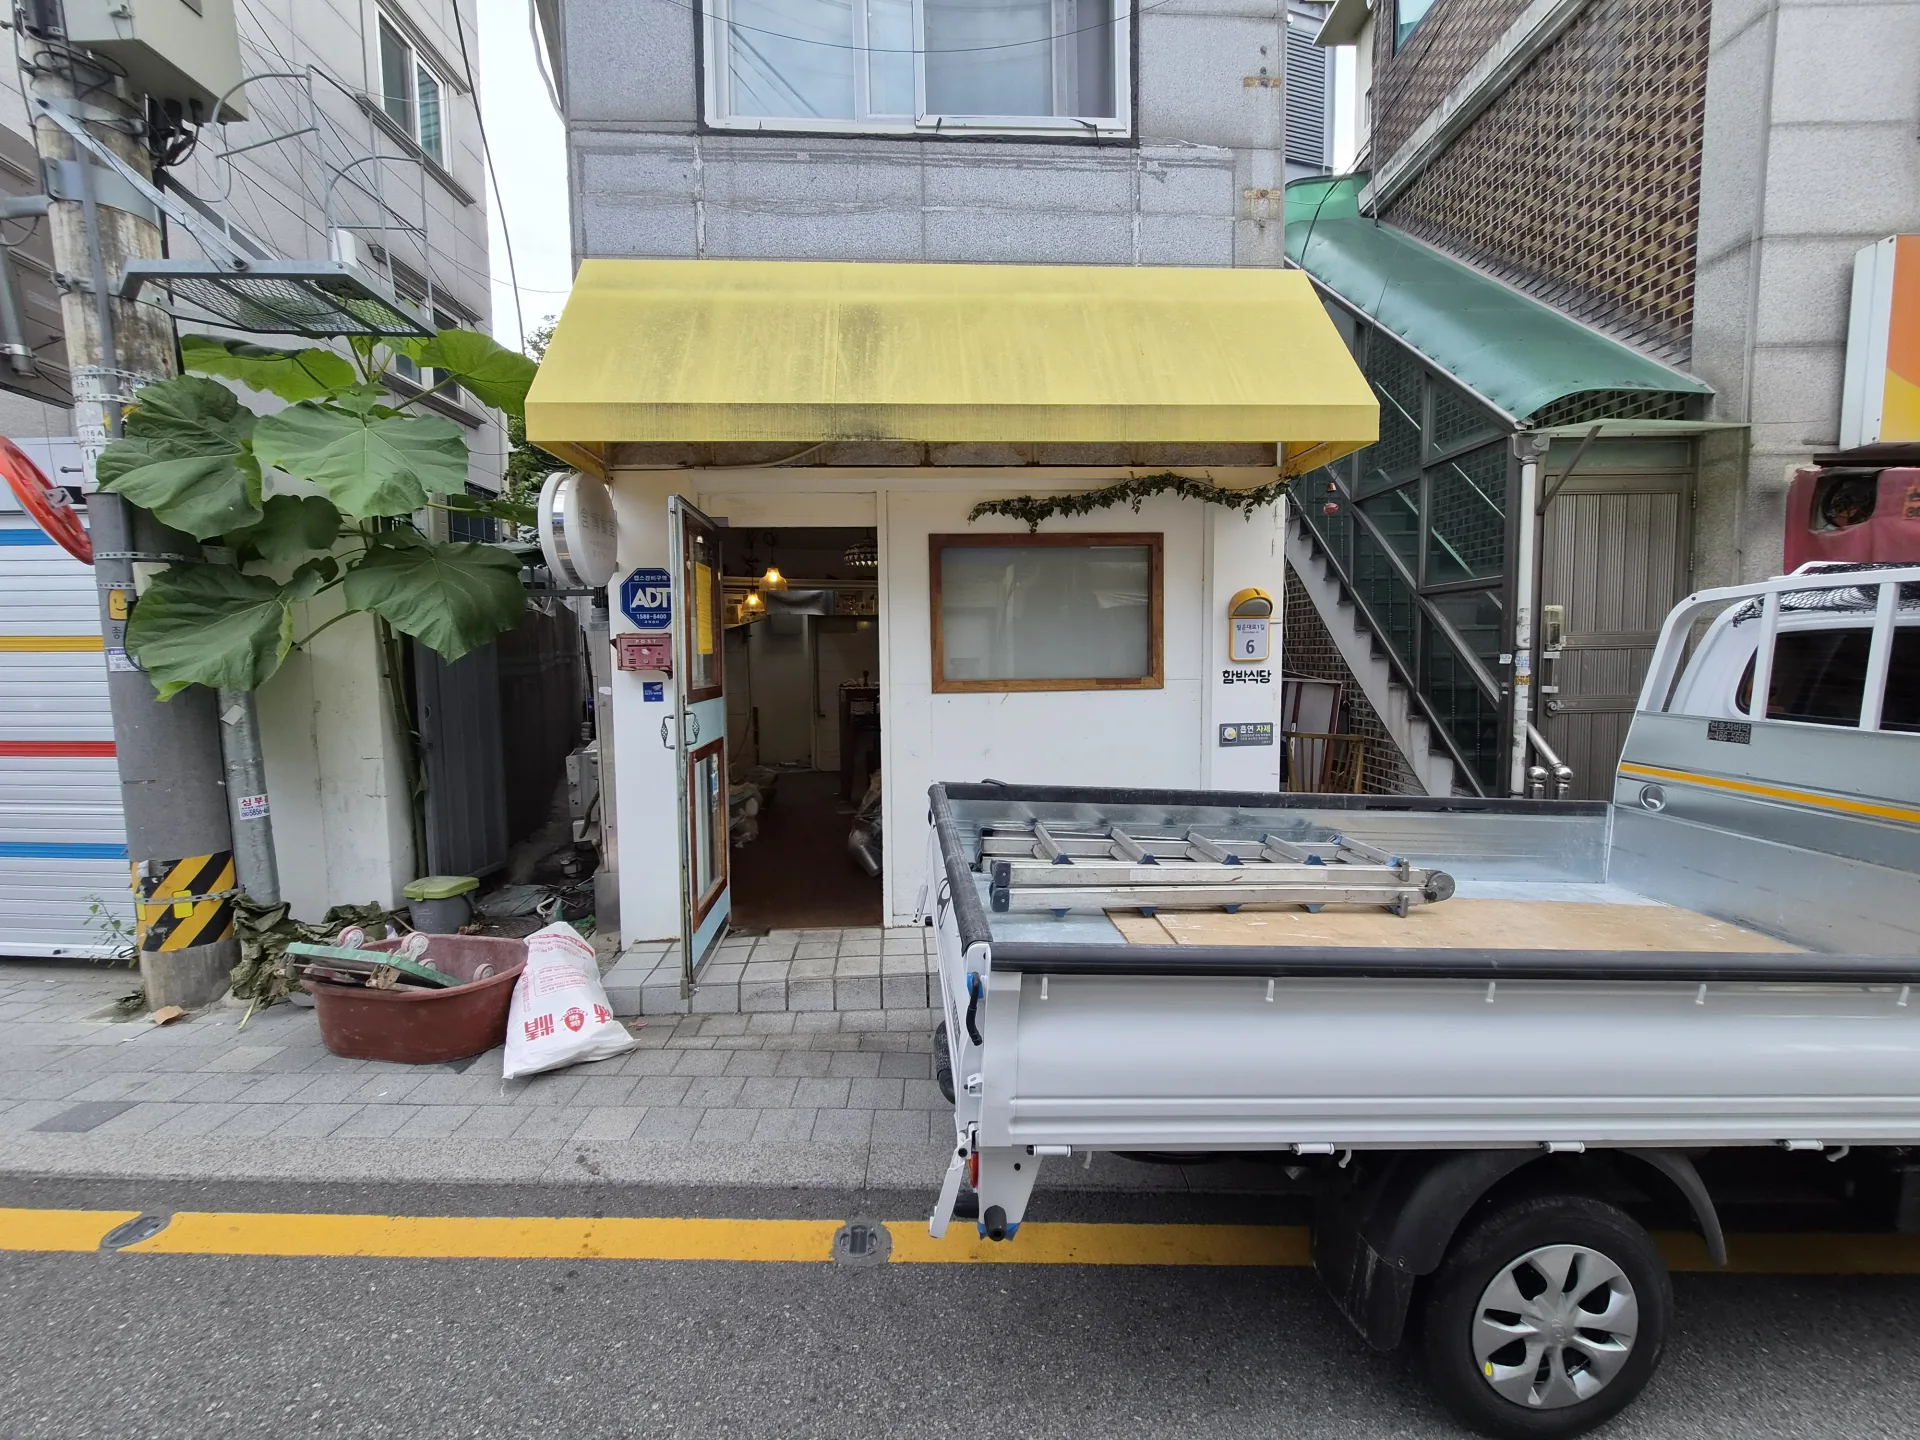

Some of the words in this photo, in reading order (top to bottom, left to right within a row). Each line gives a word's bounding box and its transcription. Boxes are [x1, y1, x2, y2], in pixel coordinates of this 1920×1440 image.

[631, 587, 671, 608] ADT
[1245, 639, 1255, 655] 6
[1222, 669, 1272, 684] 함박식당
[1240, 725, 1254, 733] 흡연
[1256, 724, 1271, 733] 자제
[524, 1013, 555, 1042] 精
